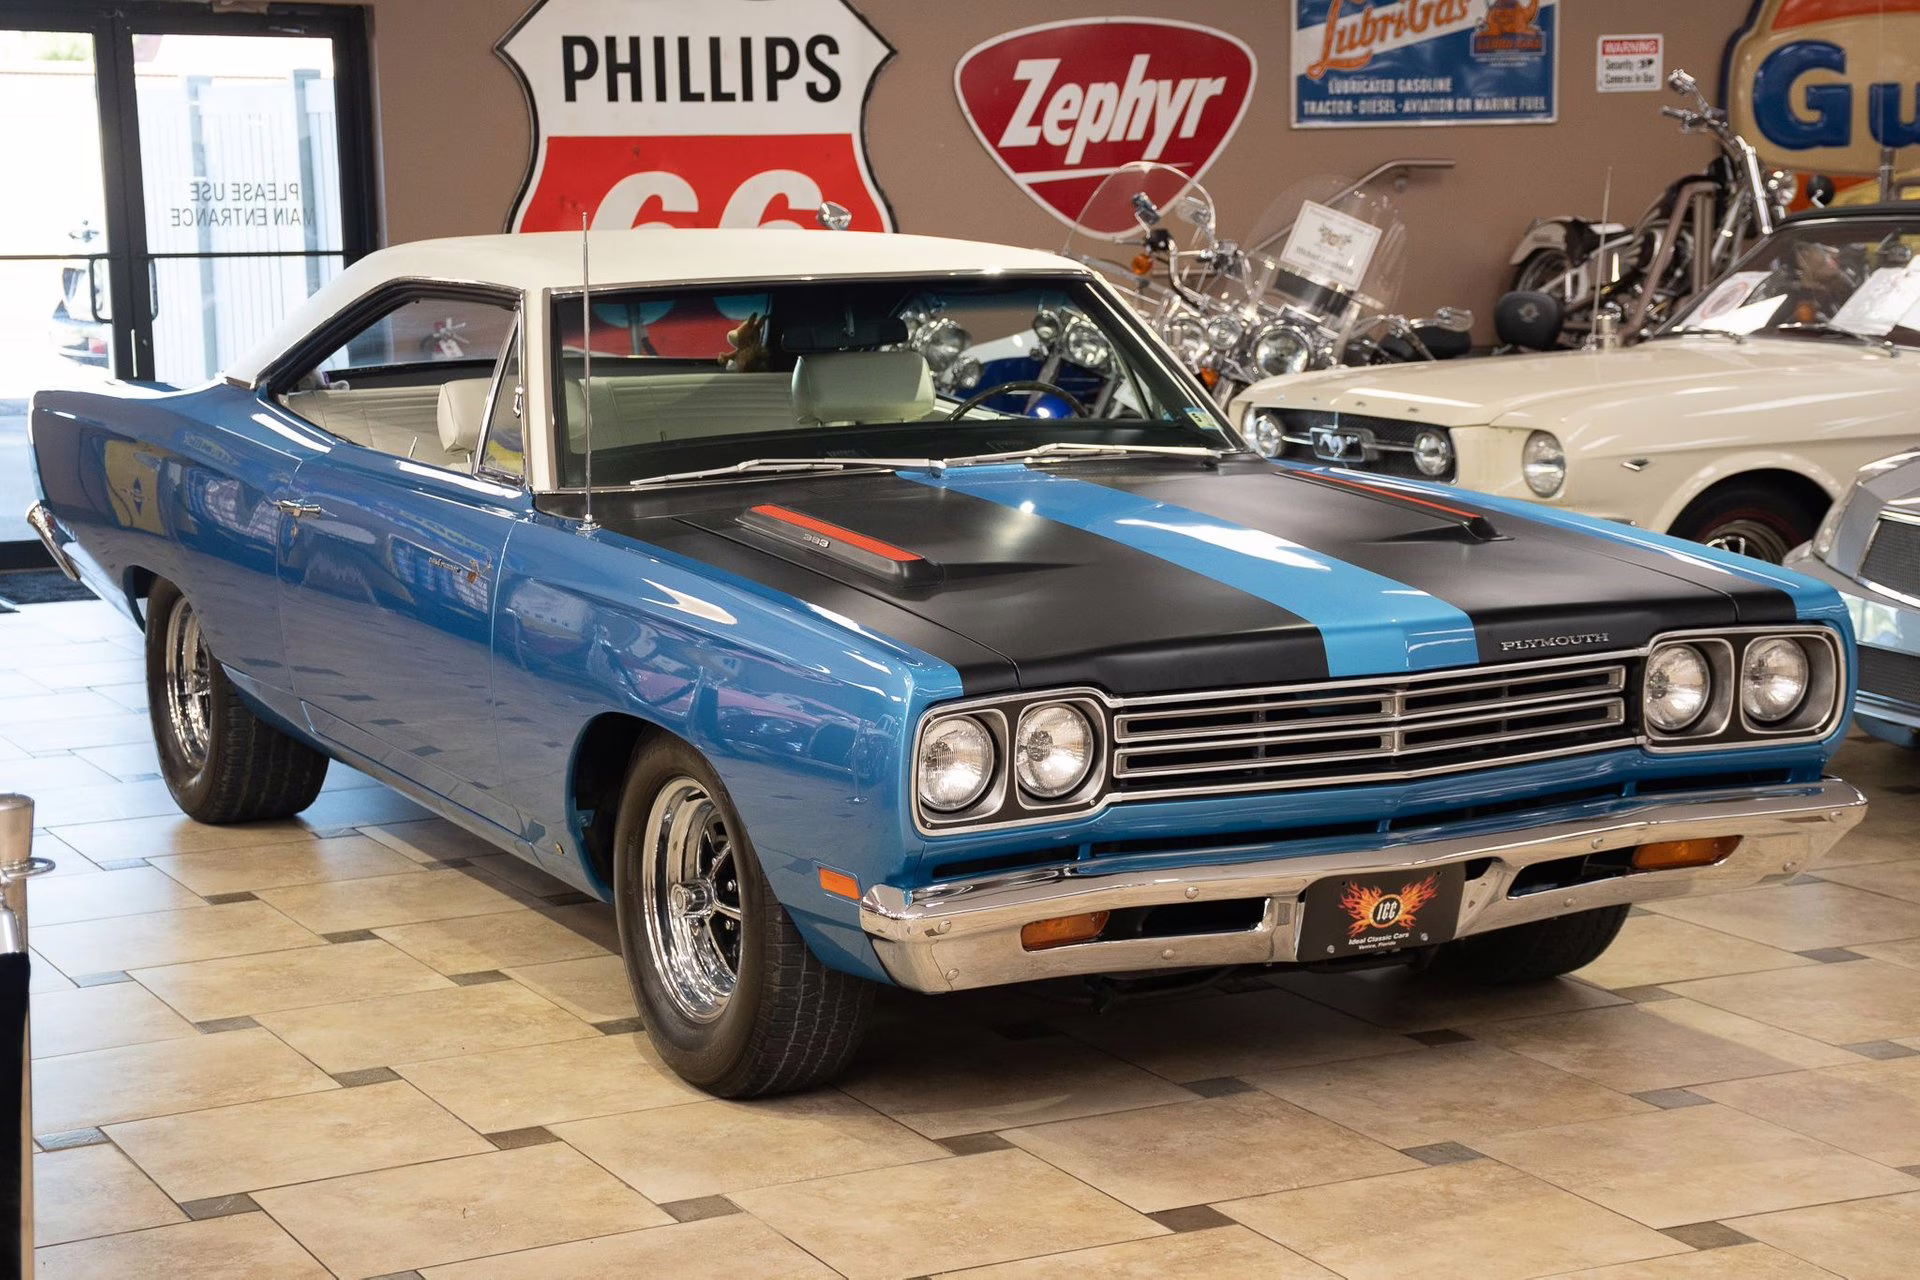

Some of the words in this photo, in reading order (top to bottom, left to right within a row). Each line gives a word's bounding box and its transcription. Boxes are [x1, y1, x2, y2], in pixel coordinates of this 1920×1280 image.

[1605, 41, 1657, 54] WARNING
[561, 33, 842, 103] PHILLIPS
[1605, 58, 1634, 70] Security
[1328, 79, 1395, 95] LUBRICATED
[1397, 77, 1453, 93] GASOLINE
[1605, 73, 1633, 84] Cameras
[997, 53, 1228, 166] Zephyr
[1474, 97, 1518, 112] MARINE
[1519, 96, 1546, 112] FUEL
[803, 532, 829, 548] 383
[1500, 632, 1609, 651] PLYMOUTH
[1376, 901, 1398, 921] ICC
[1348, 937, 1366, 945] Ideal
[1367, 934, 1392, 943] Classic
[1393, 932, 1409, 940] Cars
